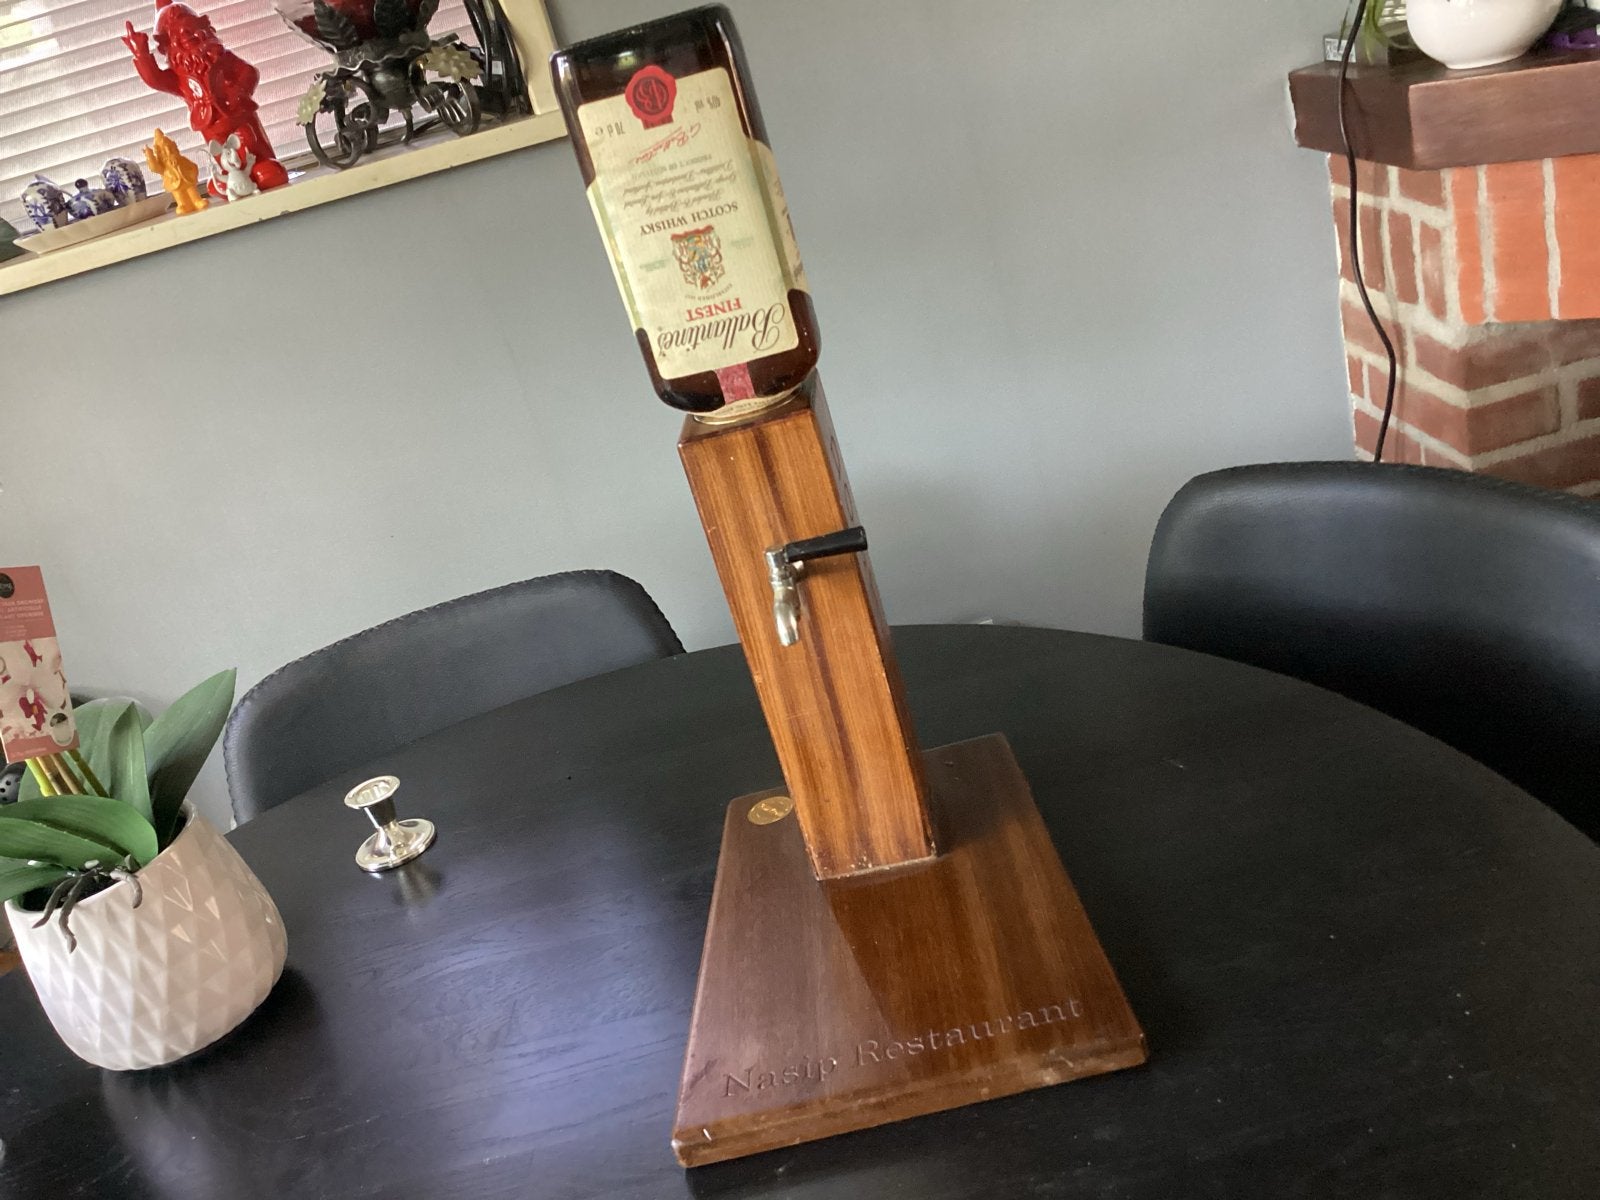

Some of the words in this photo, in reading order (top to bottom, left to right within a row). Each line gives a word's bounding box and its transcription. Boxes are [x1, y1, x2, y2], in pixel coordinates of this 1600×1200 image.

[691, 201, 738, 222] SCOTCH
[640, 216, 688, 236] WHISKY
[686, 297, 742, 322] FINEST
[657, 303, 785, 354] Ballantine's
[723, 1054, 838, 1098] Nasip
